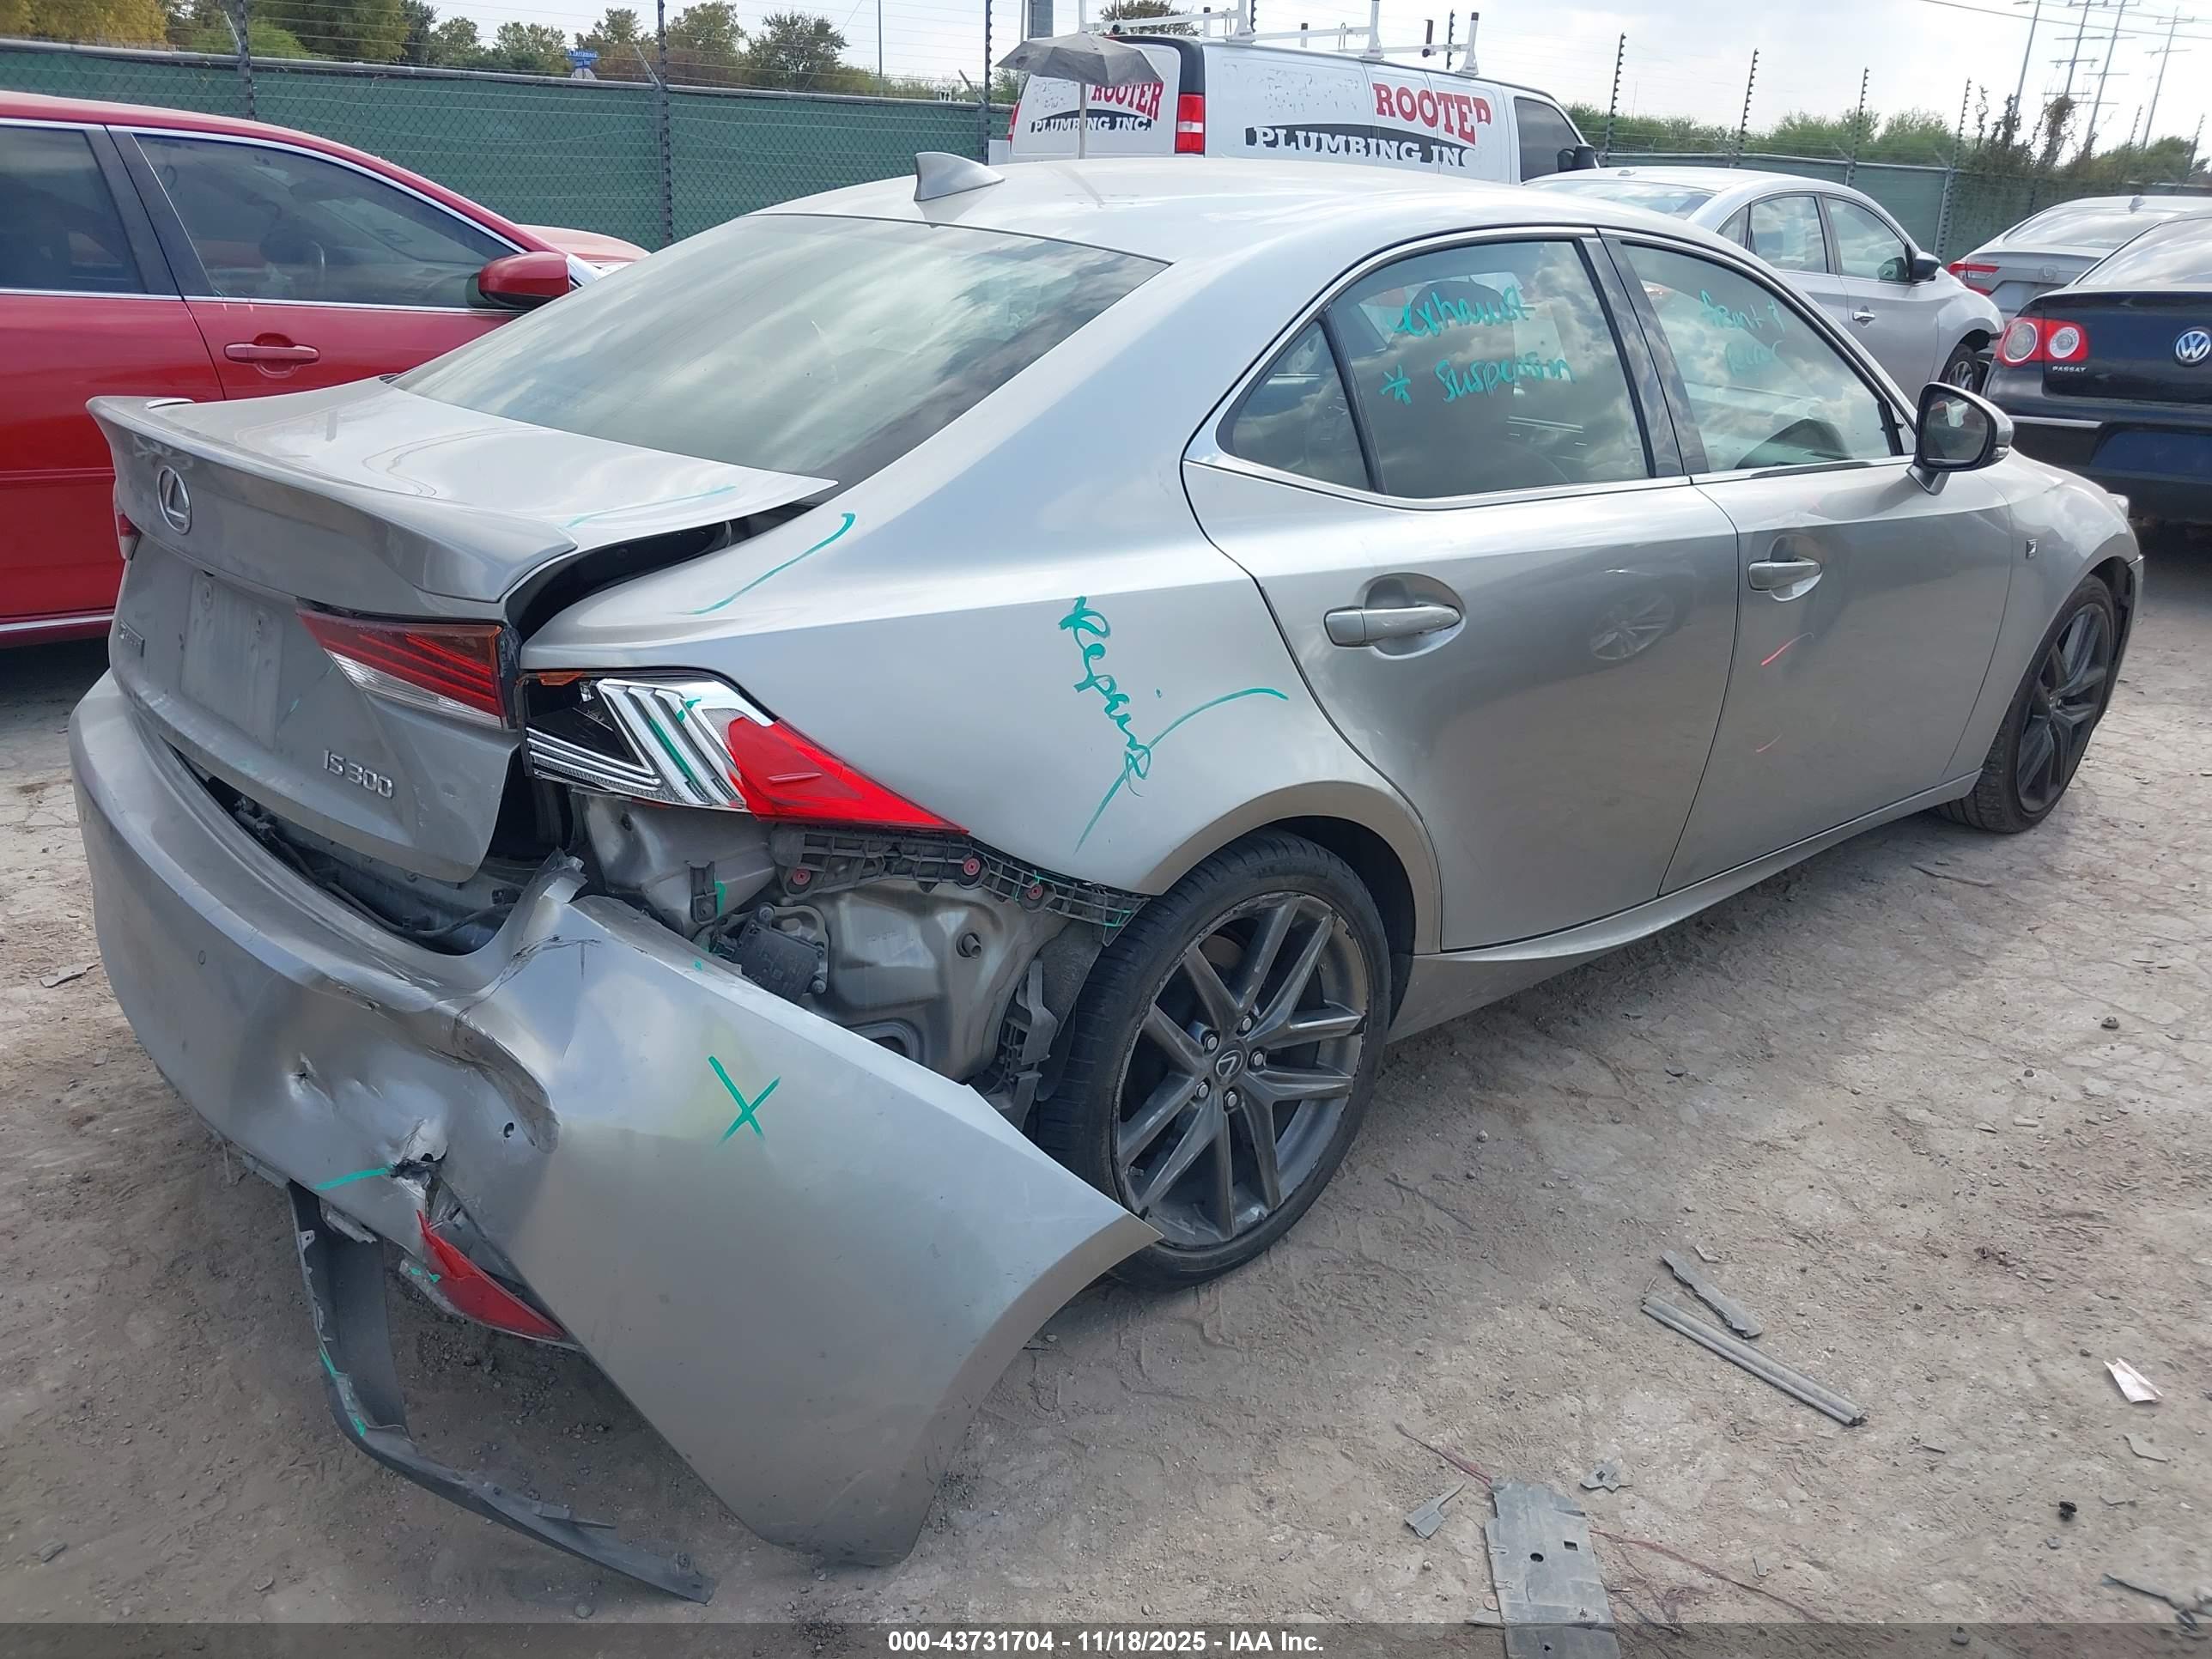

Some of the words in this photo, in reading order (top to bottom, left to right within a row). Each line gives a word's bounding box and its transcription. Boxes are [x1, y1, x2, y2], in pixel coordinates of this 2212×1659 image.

[1091, 82, 1164, 122] ROOTER
[1032, 117, 1111, 132] PLUMBNG
[1253, 126, 1422, 164] PLUMBING
[323, 749, 345, 776] IS
[348, 762, 393, 799] 300
